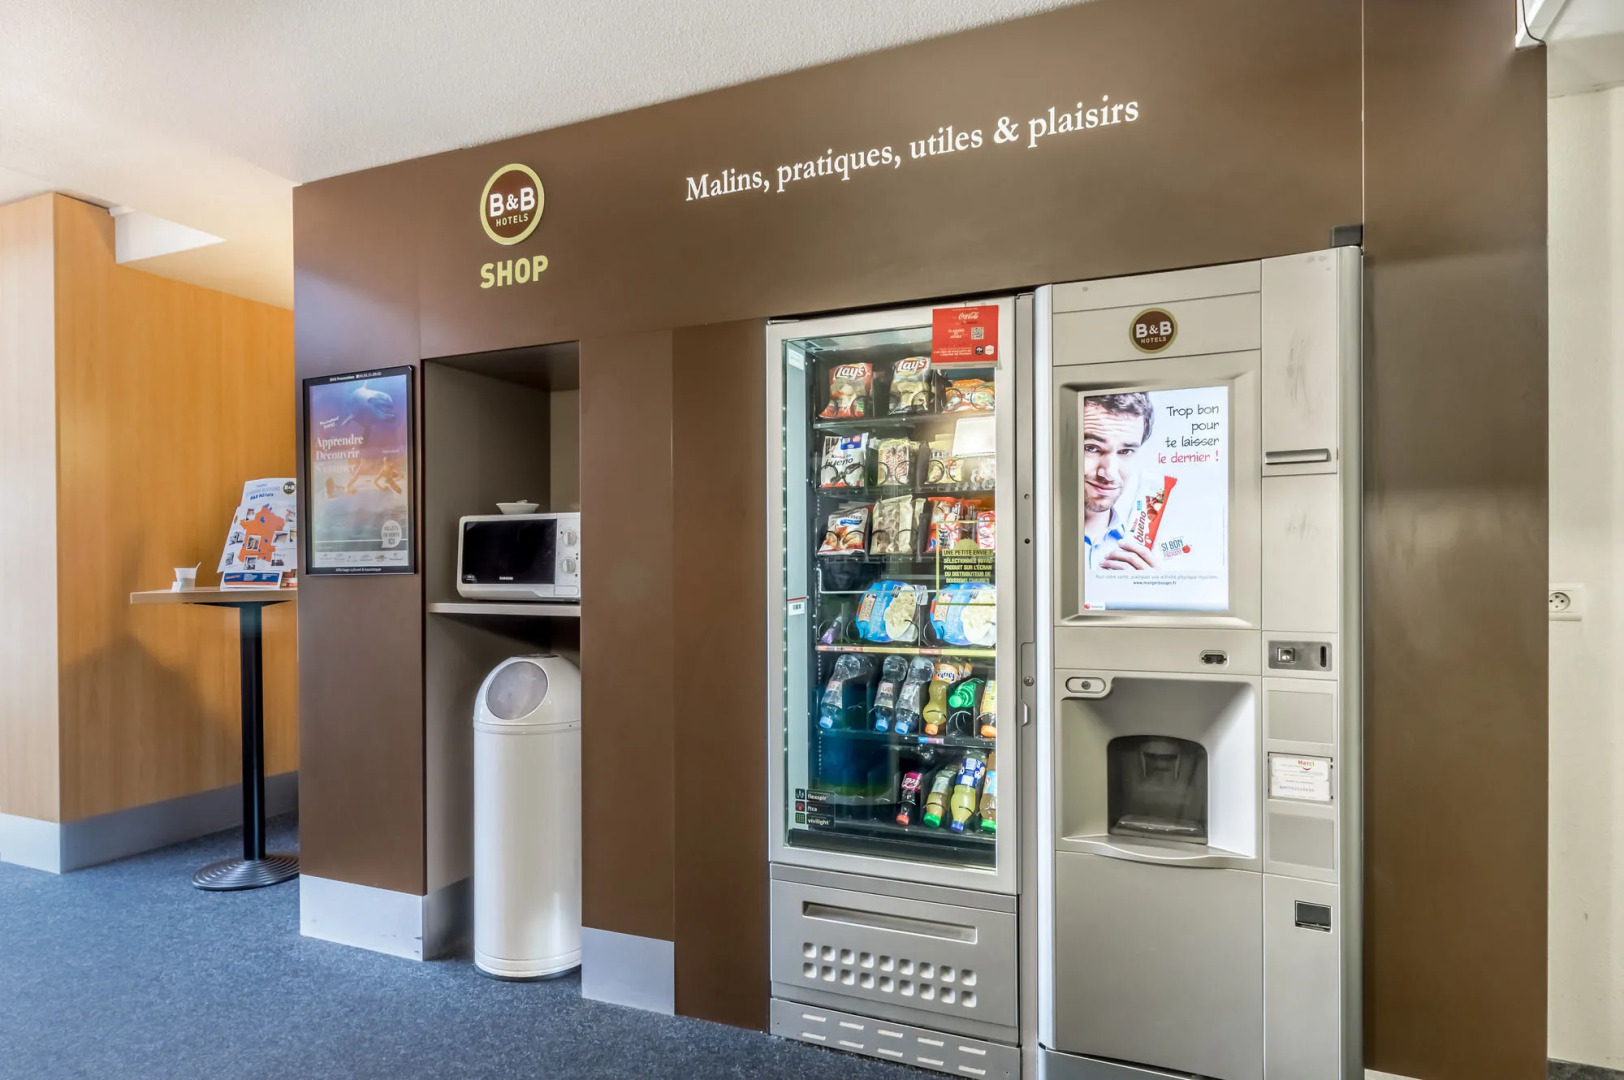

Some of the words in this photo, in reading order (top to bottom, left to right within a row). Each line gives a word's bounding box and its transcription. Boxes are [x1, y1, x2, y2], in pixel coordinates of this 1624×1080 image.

[686, 168, 770, 202] Malins,
[776, 148, 902, 193] pratiques,
[909, 125, 983, 159] utiles
[993, 116, 1019, 144] &
[1028, 95, 1139, 149] plaisirs
[490, 187, 536, 217] B&B
[495, 213, 529, 227] HOTELS
[480, 255, 549, 289] SHOP
[1136, 321, 1172, 338] B&B
[1140, 336, 1167, 344] HOTELS
[1166, 406, 1194, 419] Trop
[1197, 404, 1219, 415] bon
[1191, 421, 1220, 435] pour
[317, 433, 364, 450] Apprendre
[1165, 436, 1177, 448] te
[1181, 435, 1220, 447] laisser
[316, 447, 360, 460] Découvrir
[1158, 452, 1167, 464] le
[1170, 451, 1210, 463] dernier
[824, 457, 854, 469] bueno
[1133, 511, 1147, 543] bueno
[1169, 539, 1184, 551] BON
[1297, 759, 1315, 767] Merci
